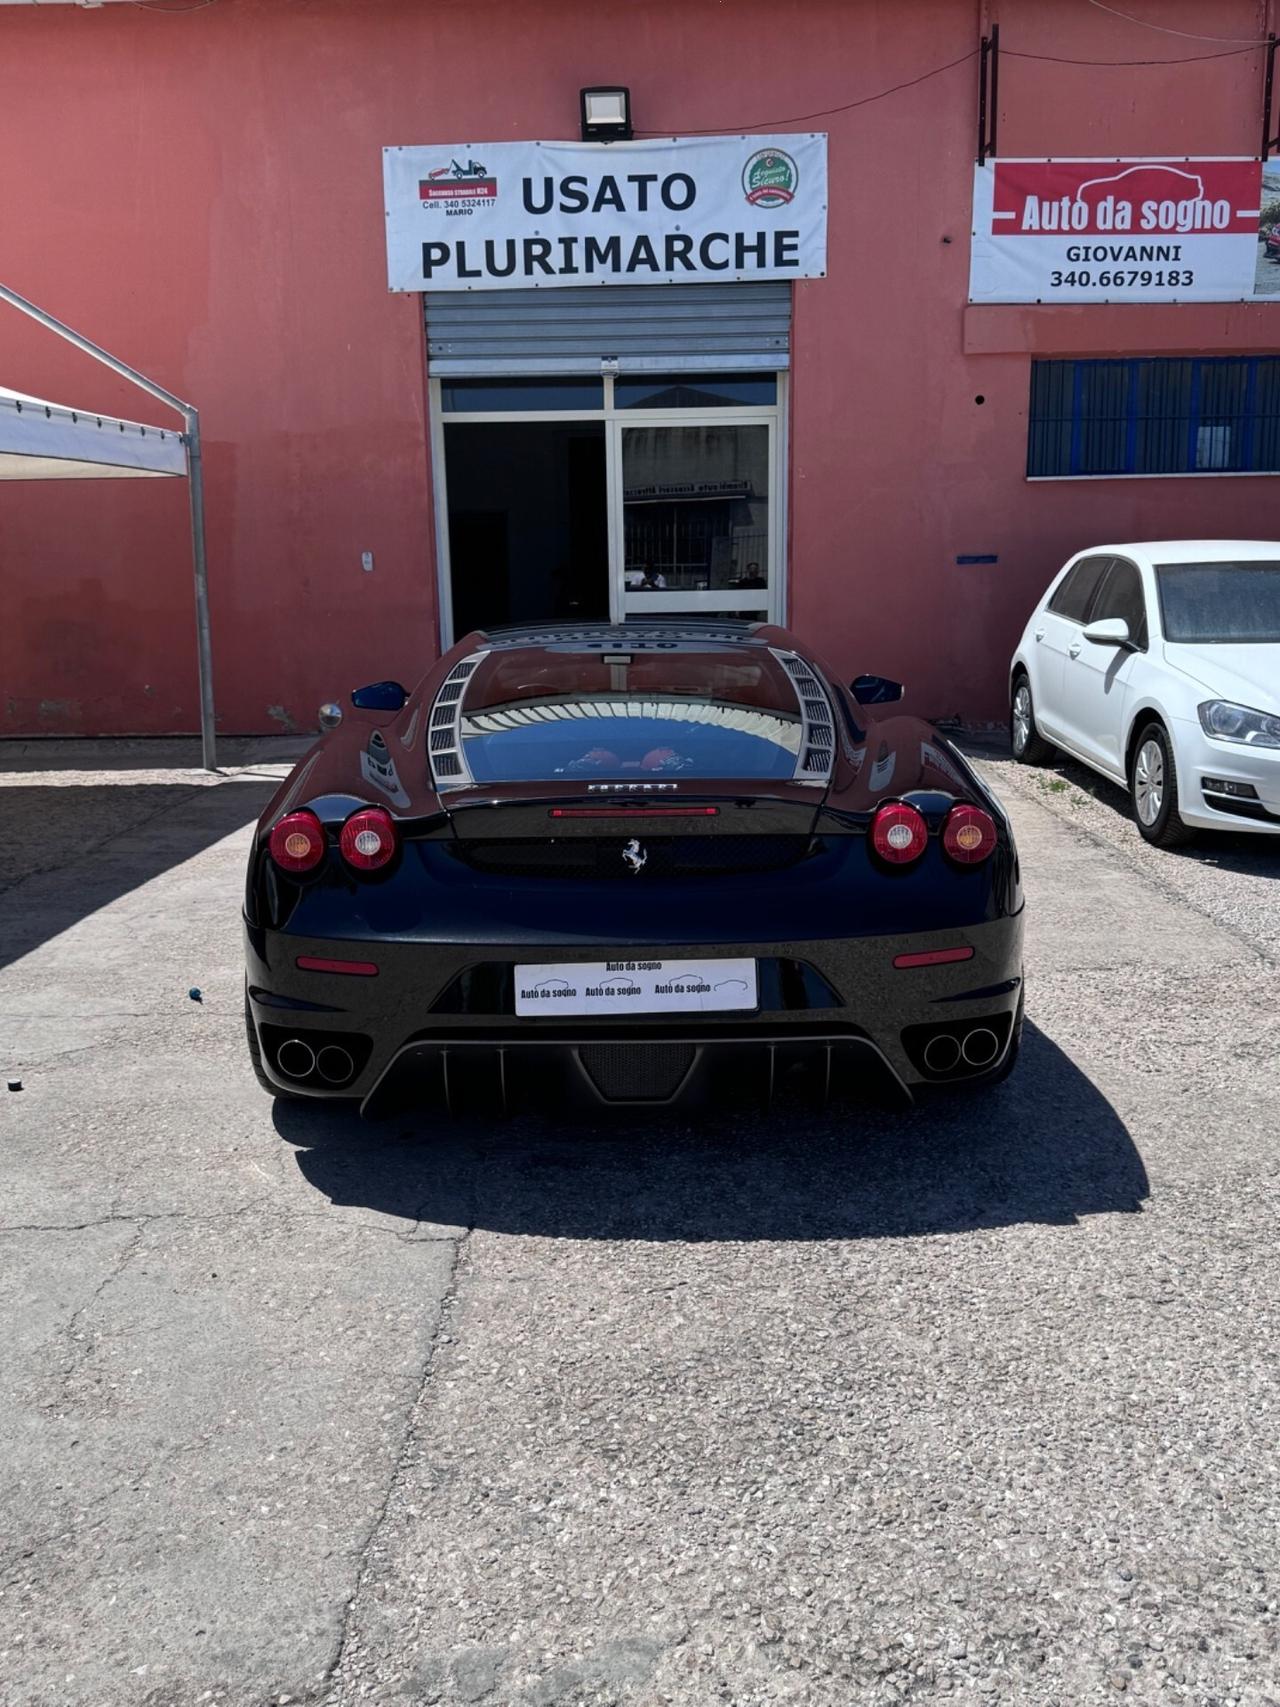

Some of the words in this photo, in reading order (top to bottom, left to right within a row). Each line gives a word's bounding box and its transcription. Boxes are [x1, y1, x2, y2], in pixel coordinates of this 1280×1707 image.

[522, 172, 697, 215] USATO
[422, 200, 442, 209] Cell.
[444, 200, 459, 209] 340
[461, 199, 496, 208] 5324117
[445, 208, 473, 216] MARIO
[1021, 195, 1089, 231] Auto
[1096, 195, 1132, 230] da
[1140, 199, 1231, 233] sogno
[422, 230, 800, 279] PLURIMARCHE
[1066, 245, 1182, 262] GIOVANNI
[1050, 270, 1194, 287] 340.6679183
[606, 961, 624, 971] Auto
[626, 961, 636, 971] da
[637, 962, 662, 972] sogno
[521, 989, 539, 999] Auto
[540, 989, 551, 998] da
[552, 989, 577, 998] sogno
[585, 987, 603, 997] Auto
[605, 986, 615, 996] da
[616, 987, 641, 996] sogno
[655, 984, 673, 994] Auto
[674, 983, 685, 993] da
[686, 984, 711, 994] sogno
